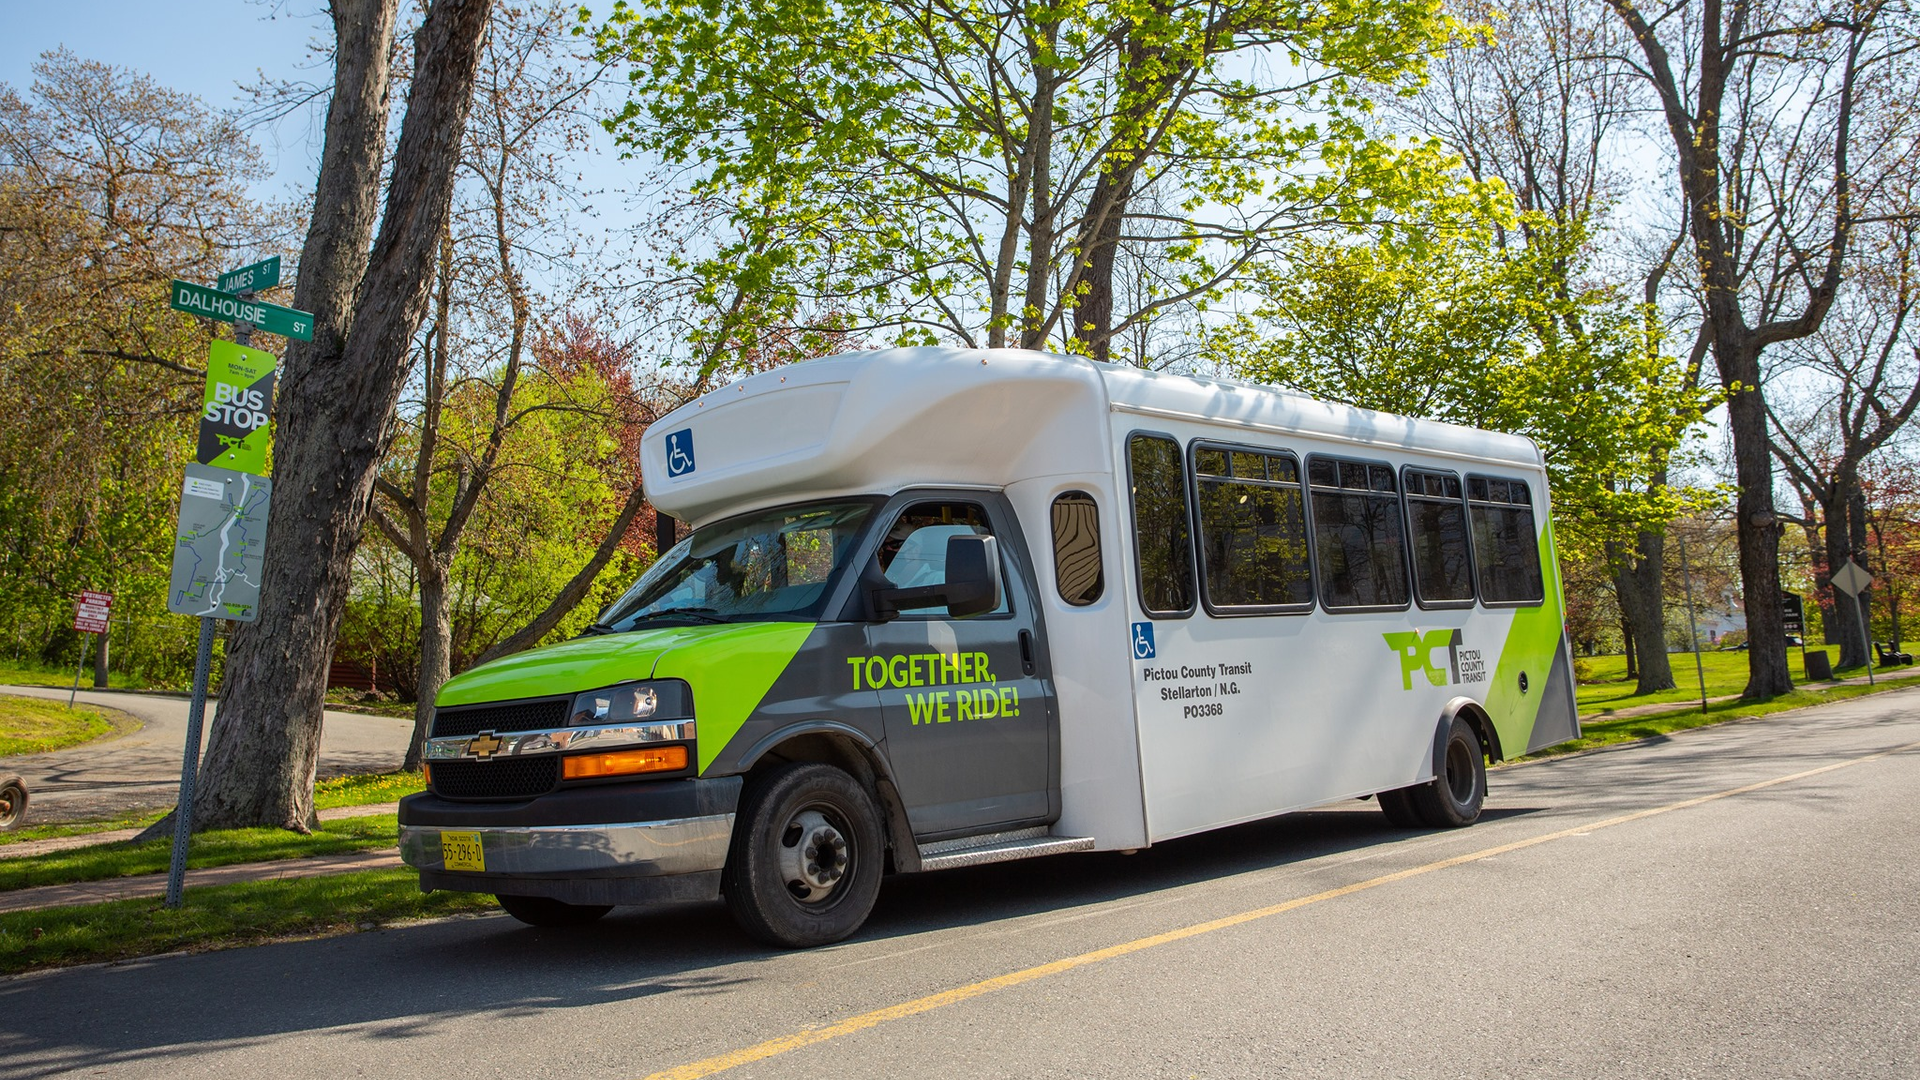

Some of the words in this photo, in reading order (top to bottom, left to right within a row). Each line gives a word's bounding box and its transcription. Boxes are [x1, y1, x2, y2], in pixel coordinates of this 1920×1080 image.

[223, 270, 254, 292] JAMES
[262, 263, 272, 274] ST
[179, 289, 266, 324] DALHOUSIE
[293, 321, 307, 334] ST
[228, 363, 257, 375] MON-SAT
[215, 382, 265, 411] BUS
[204, 401, 269, 430] STOP
[215, 433, 245, 449] PCT
[83, 592, 112, 601] RESTRICTED
[85, 598, 107, 606] PARKING
[1382, 628, 1463, 691] PCT
[1459, 649, 1481, 661] PICTOU
[847, 652, 997, 690] TOGETHER,
[1143, 667, 1178, 681] Pictou
[1181, 664, 1216, 679] County
[1218, 662, 1252, 676] Transit
[1461, 660, 1485, 672] COUNTY
[1462, 671, 1486, 684] TRANSIT
[1160, 686, 1212, 701] Stellarton
[1219, 681, 1241, 695] N.G.
[905, 691, 951, 725] WE
[956, 686, 1020, 721] RIDE!
